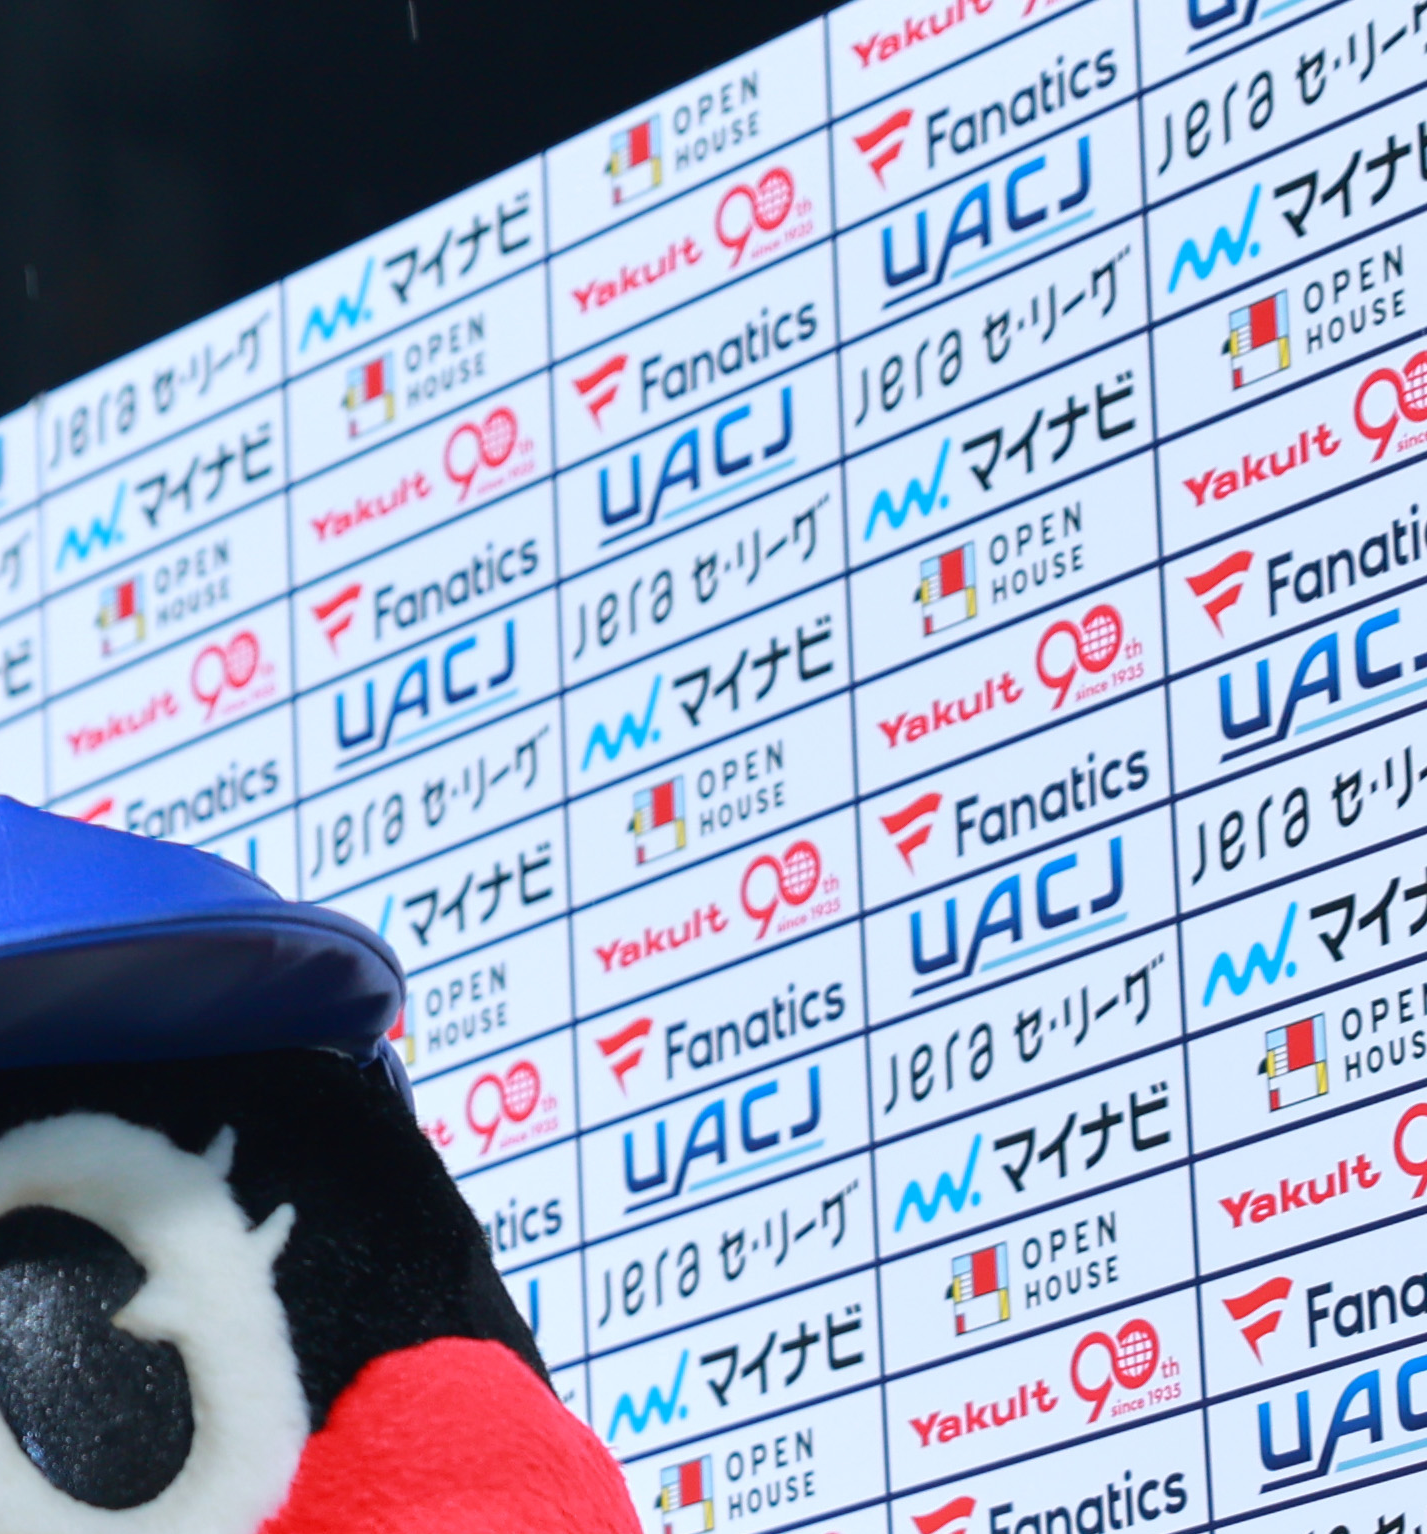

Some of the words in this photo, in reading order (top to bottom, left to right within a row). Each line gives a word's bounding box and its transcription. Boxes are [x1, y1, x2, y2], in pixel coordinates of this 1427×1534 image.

[673, 69, 757, 135] OPEN
[676, 109, 759, 172] HOUSE
[926, 48, 1117, 170] Fanatics
[383, 189, 530, 305] マイナビ
[880, 133, 1094, 311] UACJ
[571, 236, 703, 314] Yakult
[982, 243, 1130, 364] セ・リーグ
[1303, 243, 1403, 313] OPEN
[405, 311, 483, 373] OPEN
[640, 301, 817, 414] Fanatics
[1306, 287, 1405, 354] HOUSE
[598, 383, 795, 549] UACJ
[961, 368, 1136, 492] マイナビ
[1182, 424, 1340, 506] Yakult
[310, 470, 433, 542] Yakult
[989, 500, 1081, 565] OPEN
[691, 492, 828, 604] セ・リーグ
[992, 543, 1083, 604] HOUSE
[1267, 502, 1427, 617] Fanati
[374, 538, 537, 641] Fanatics
[335, 617, 517, 771] UACJ
[672, 613, 833, 727] マイナビ
[1112, 662, 1143, 686] 1935
[1218, 606, 1427, 764] UAC
[877, 672, 1023, 748] Yakult
[697, 739, 782, 799] OPEN
[700, 780, 784, 836] HOUSE
[955, 749, 1149, 857] Fanatics
[403, 841, 552, 947] マイナビ
[810, 897, 840, 919] 1935
[909, 835, 1127, 997] UACJ
[594, 903, 728, 972] Yakult
[426, 961, 505, 1017] OPEN
[1013, 952, 1163, 1063] セ・リーグ
[1342, 982, 1427, 1041] OPE
[665, 982, 844, 1080] Fanatics
[623, 1065, 823, 1215] UACJ
[993, 1080, 1171, 1192] マイナビ
[1219, 1155, 1380, 1226] Yakult
[718, 1179, 857, 1282] セ・リーグ
[1022, 1211, 1116, 1269] OPEN
[1025, 1255, 1118, 1308] HOUSE
[699, 1303, 863, 1407] マイナビ
[1148, 1383, 1180, 1404] 1935
[909, 1380, 1057, 1445] Yakult
[726, 1428, 812, 1482] OPEN
[729, 1471, 814, 1520] HOUSE
